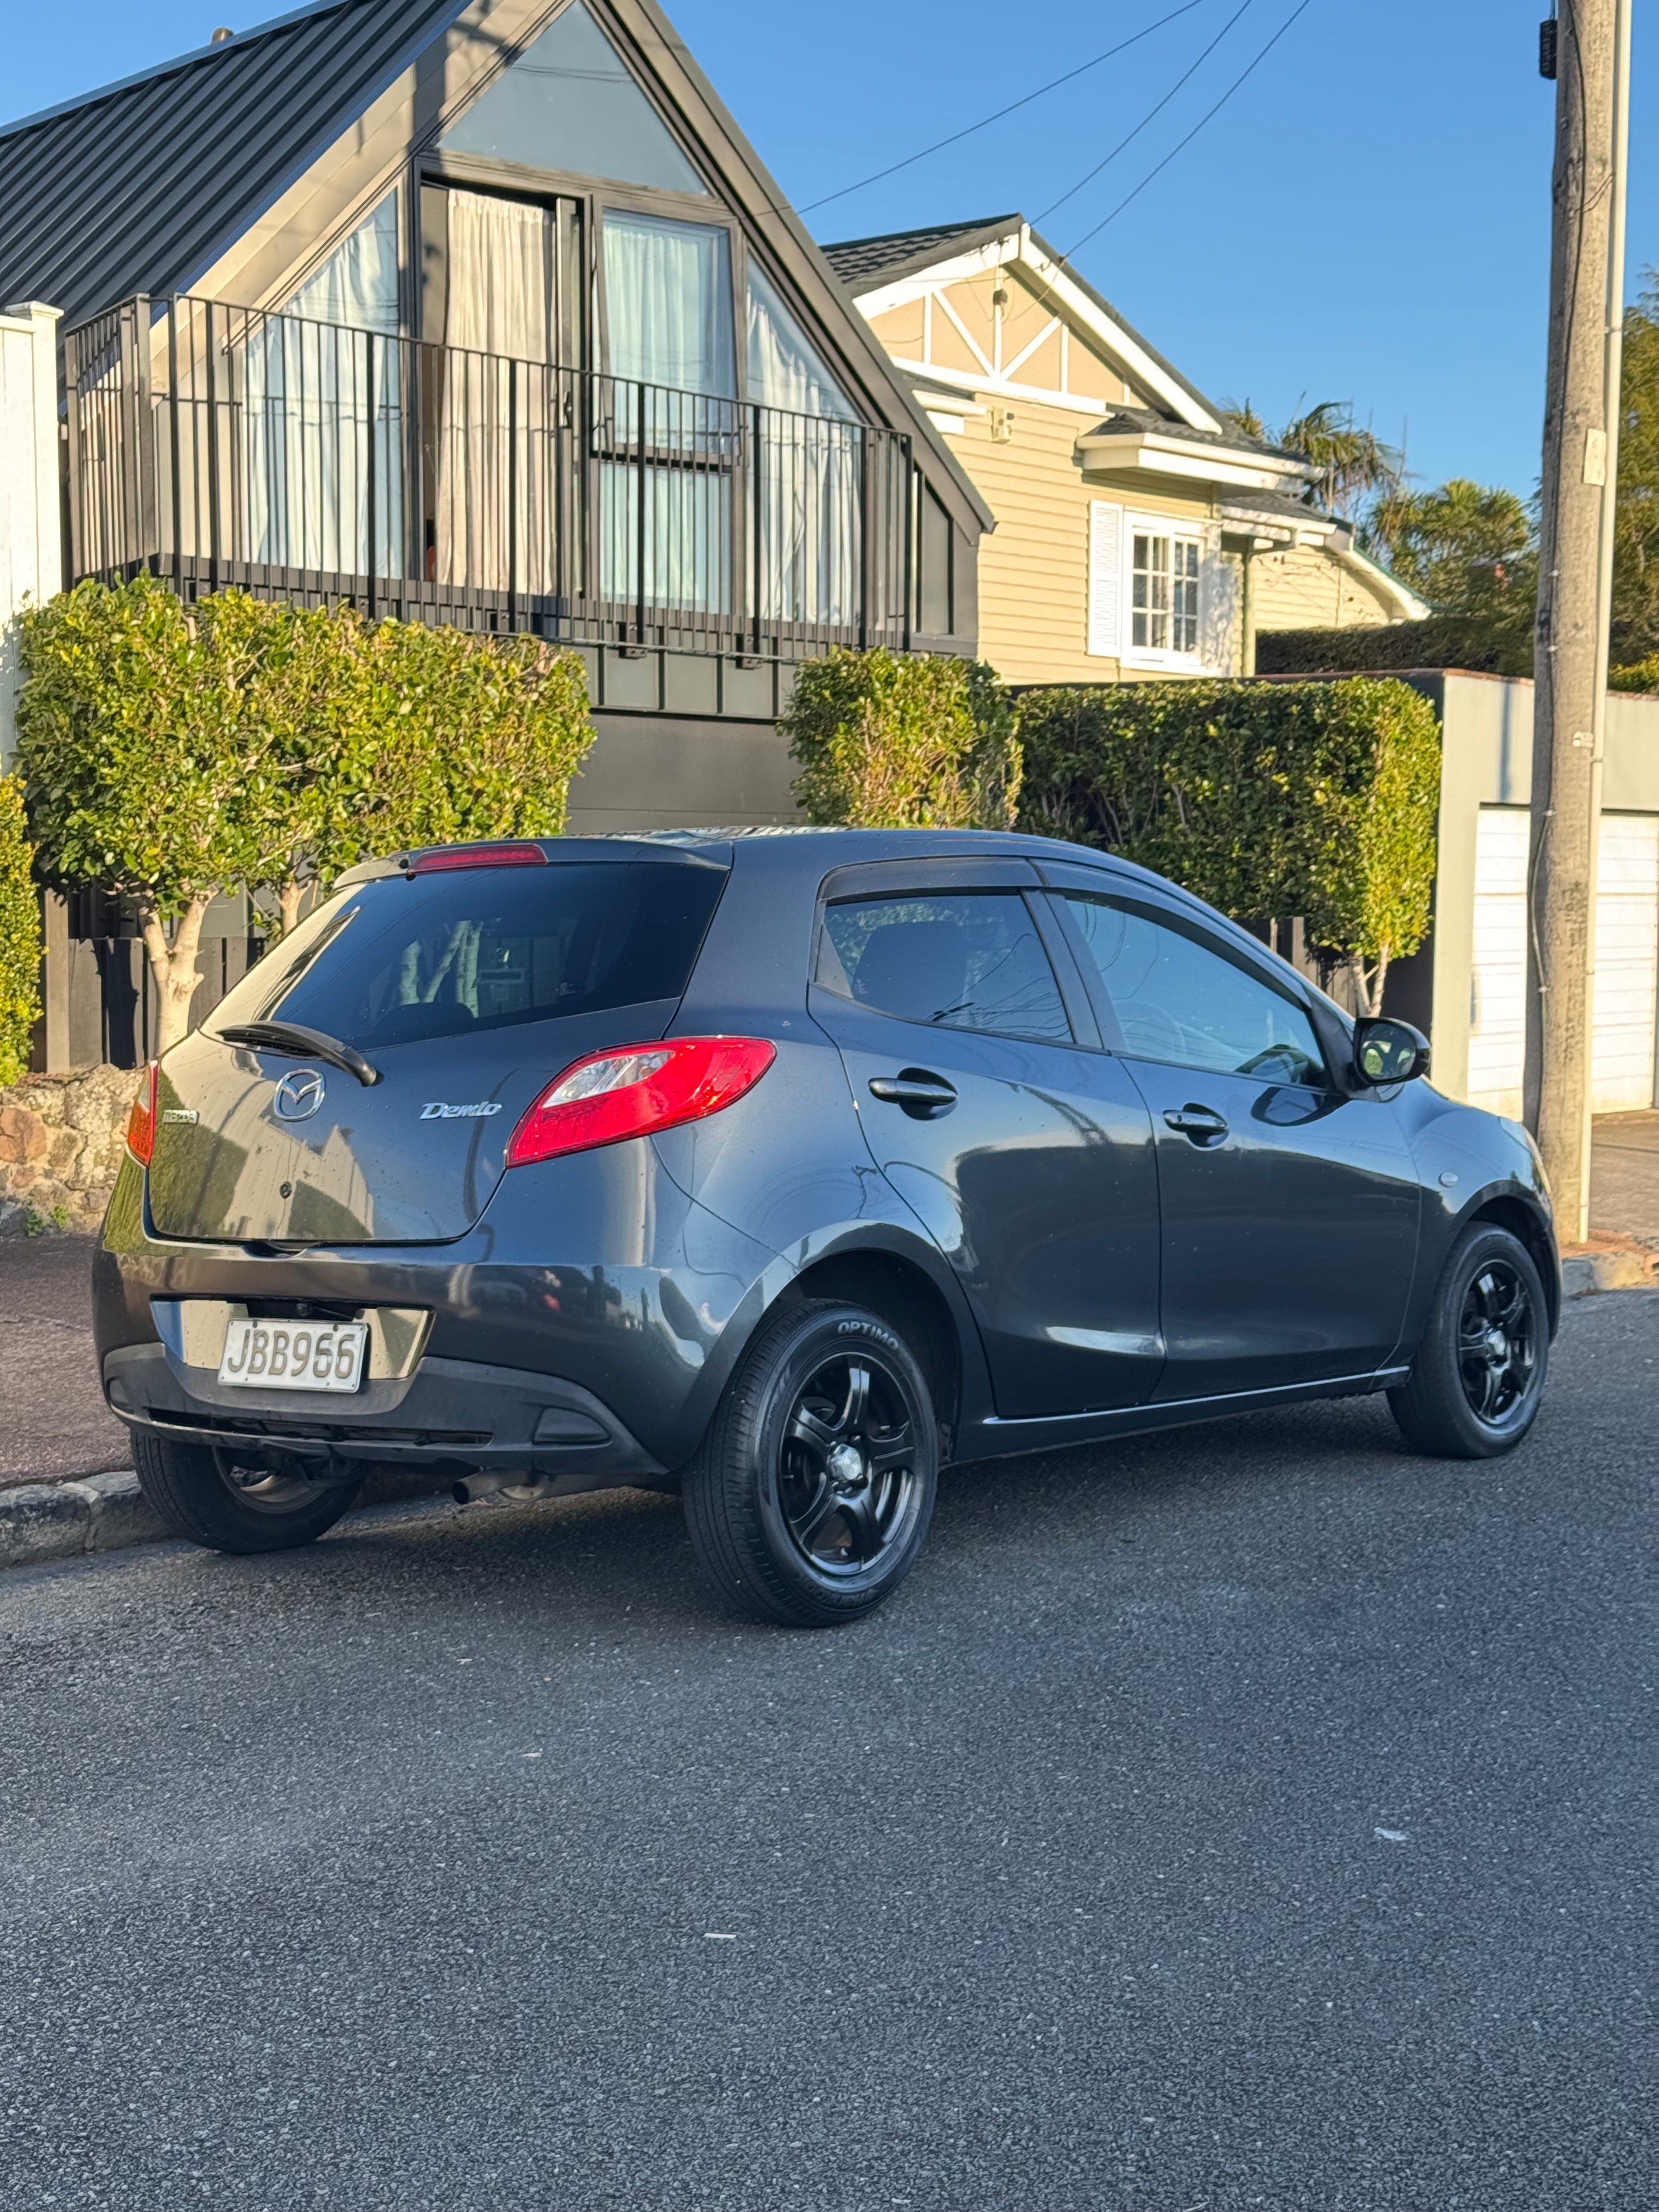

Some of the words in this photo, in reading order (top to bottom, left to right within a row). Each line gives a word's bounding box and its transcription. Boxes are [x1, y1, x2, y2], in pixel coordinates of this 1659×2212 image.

[419, 1101, 502, 1120] Demio
[838, 1321, 899, 1350] OPTIMO
[228, 1329, 355, 1379] JBB966
